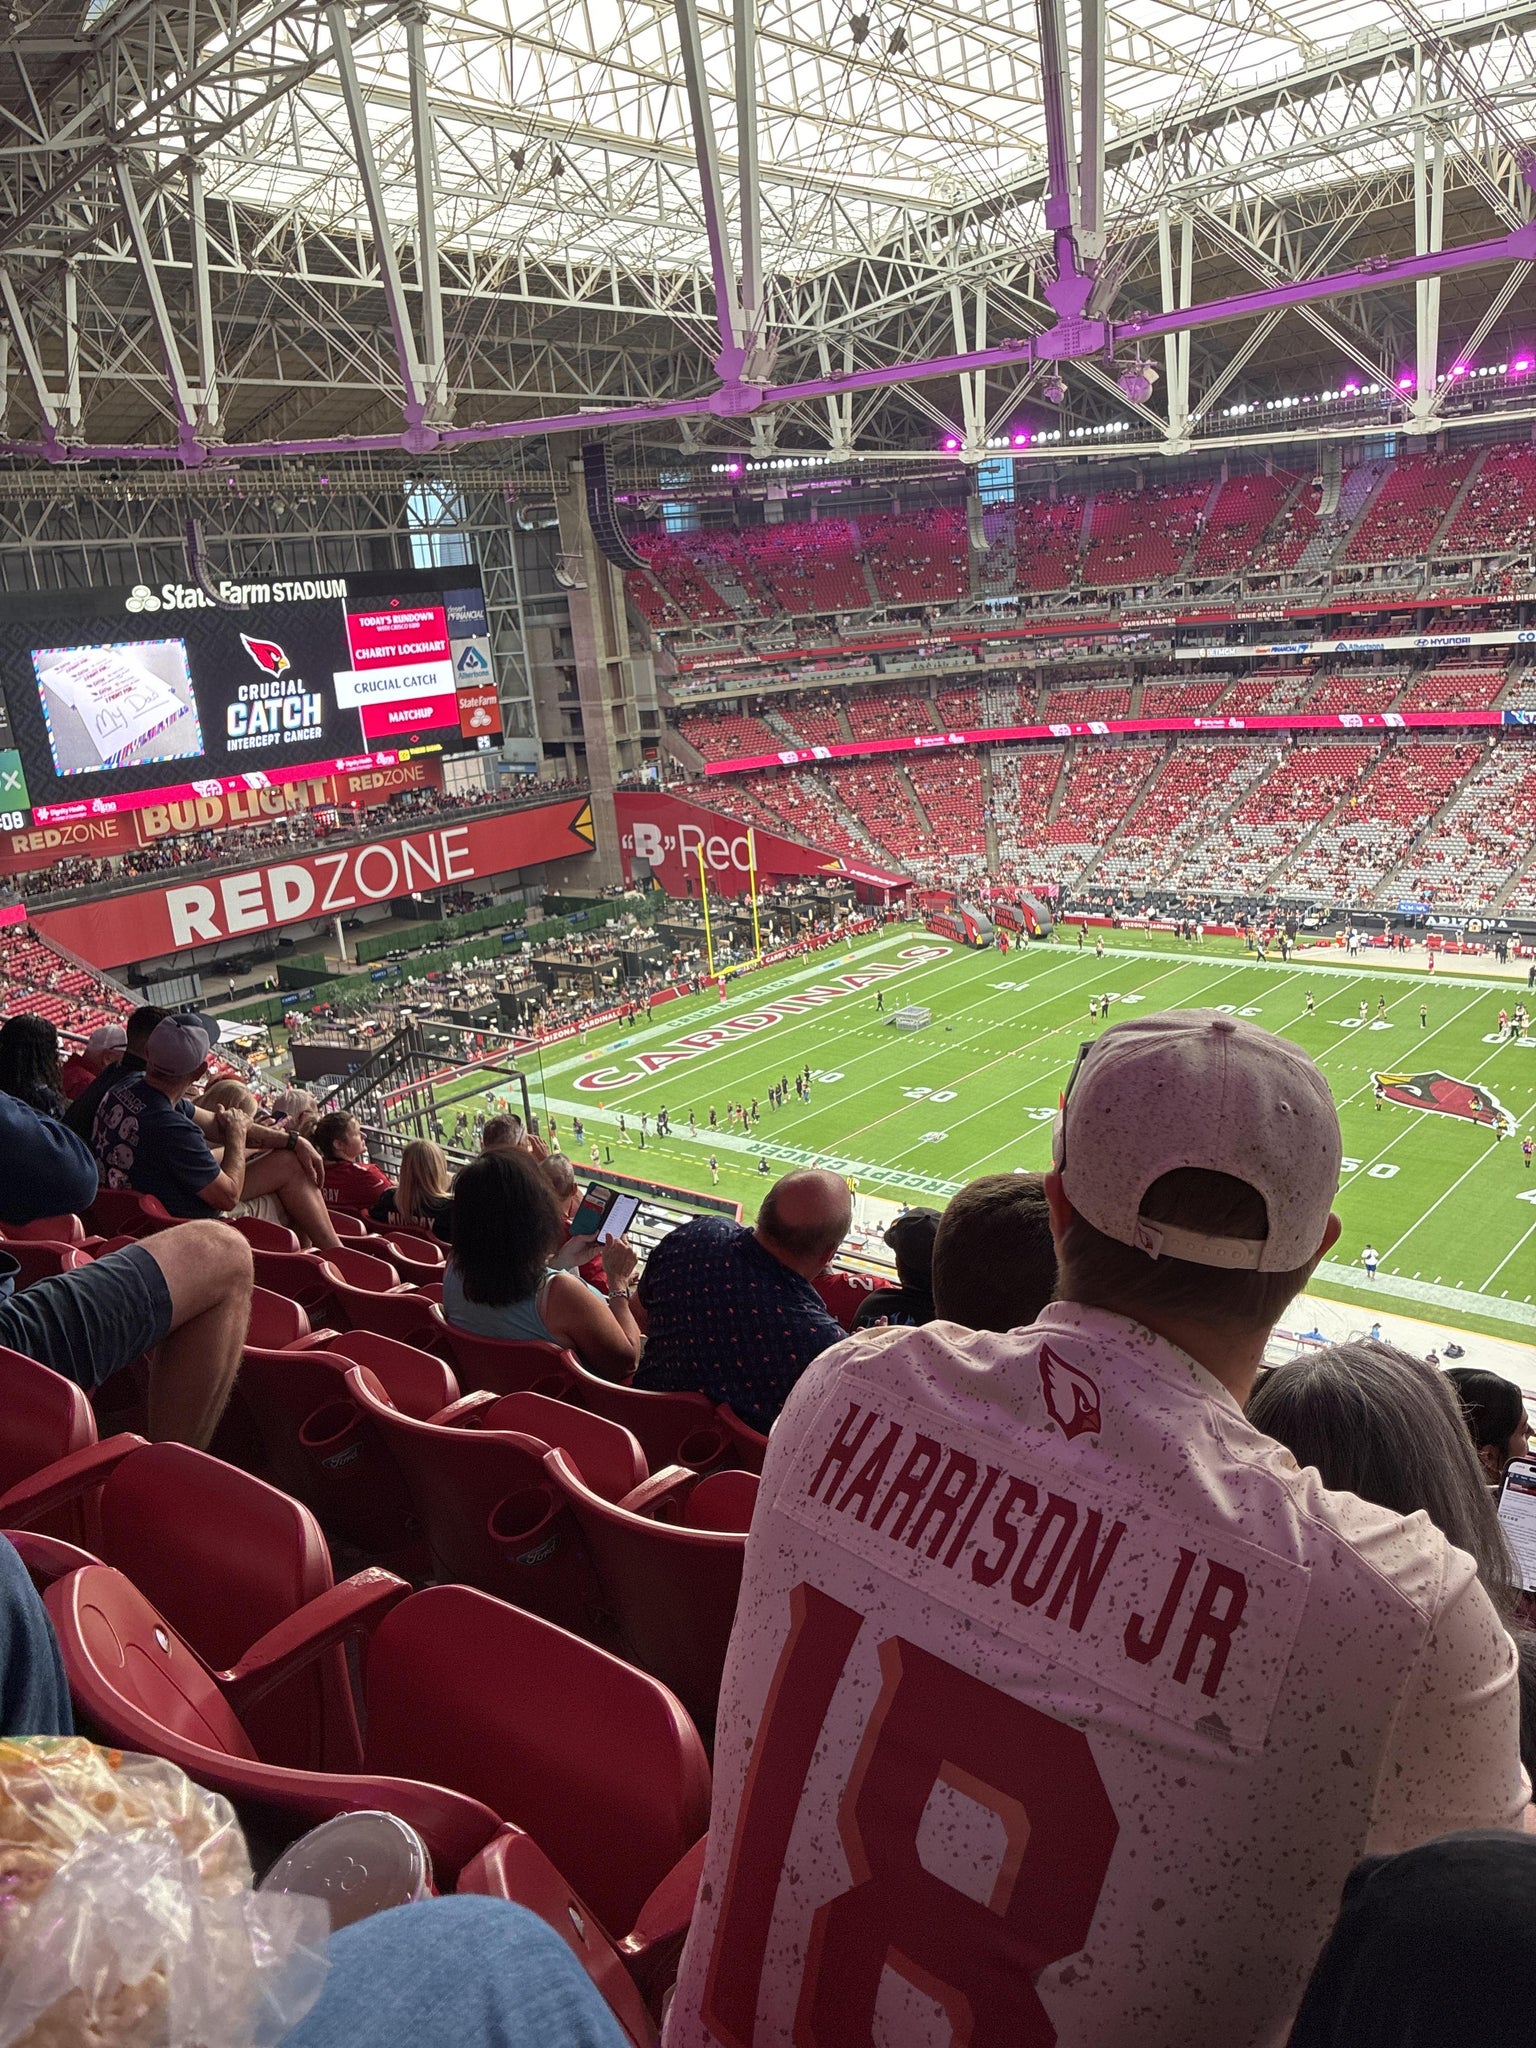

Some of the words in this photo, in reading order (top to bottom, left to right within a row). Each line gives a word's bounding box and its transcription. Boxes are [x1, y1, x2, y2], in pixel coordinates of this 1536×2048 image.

[219, 580, 270, 604] Farm
[272, 579, 347, 601] STADIUM
[359, 614, 393, 627] TODAY'S
[393, 612, 434, 625] RUNDOWN
[355, 646, 398, 661] CHARITY
[398, 640, 446, 655] LOCKHART
[1271, 645, 1297, 653] FINANCIAL
[1349, 643, 1385, 651] Albertsons
[1430, 637, 1471, 645] HYUNDAI
[354, 678, 400, 694] CRUCIAL
[403, 674, 437, 688] CATCH
[458, 670, 490, 679] Albertsons
[237, 679, 306, 701] CRUCIAL
[226, 693, 322, 738] CATCH
[388, 706, 434, 724] MATCHUP
[227, 735, 281, 752] INTERCEPT
[283, 727, 322, 743] CANCER
[141, 795, 224, 837] BUD
[227, 776, 330, 821] LIGHT
[850, 870, 898, 886] verizon
[926, 921, 965, 944] CARDINALS
[1425, 916, 1508, 931] ARIZONA
[666, 997, 742, 1028] CRUCIAL
[742, 979, 796, 1000] CATCH
[573, 945, 953, 1092] CARDINALS
[540, 1025, 577, 1045] ARIZONA
[902, 1086, 958, 1103] 20
[747, 1142, 843, 1171] CANCER
[1342, 1156, 1401, 1179] 50
[808, 1402, 1128, 1633] HARRISON
[1123, 1548, 1249, 1699] JR
[700, 1581, 1121, 2048] 18
